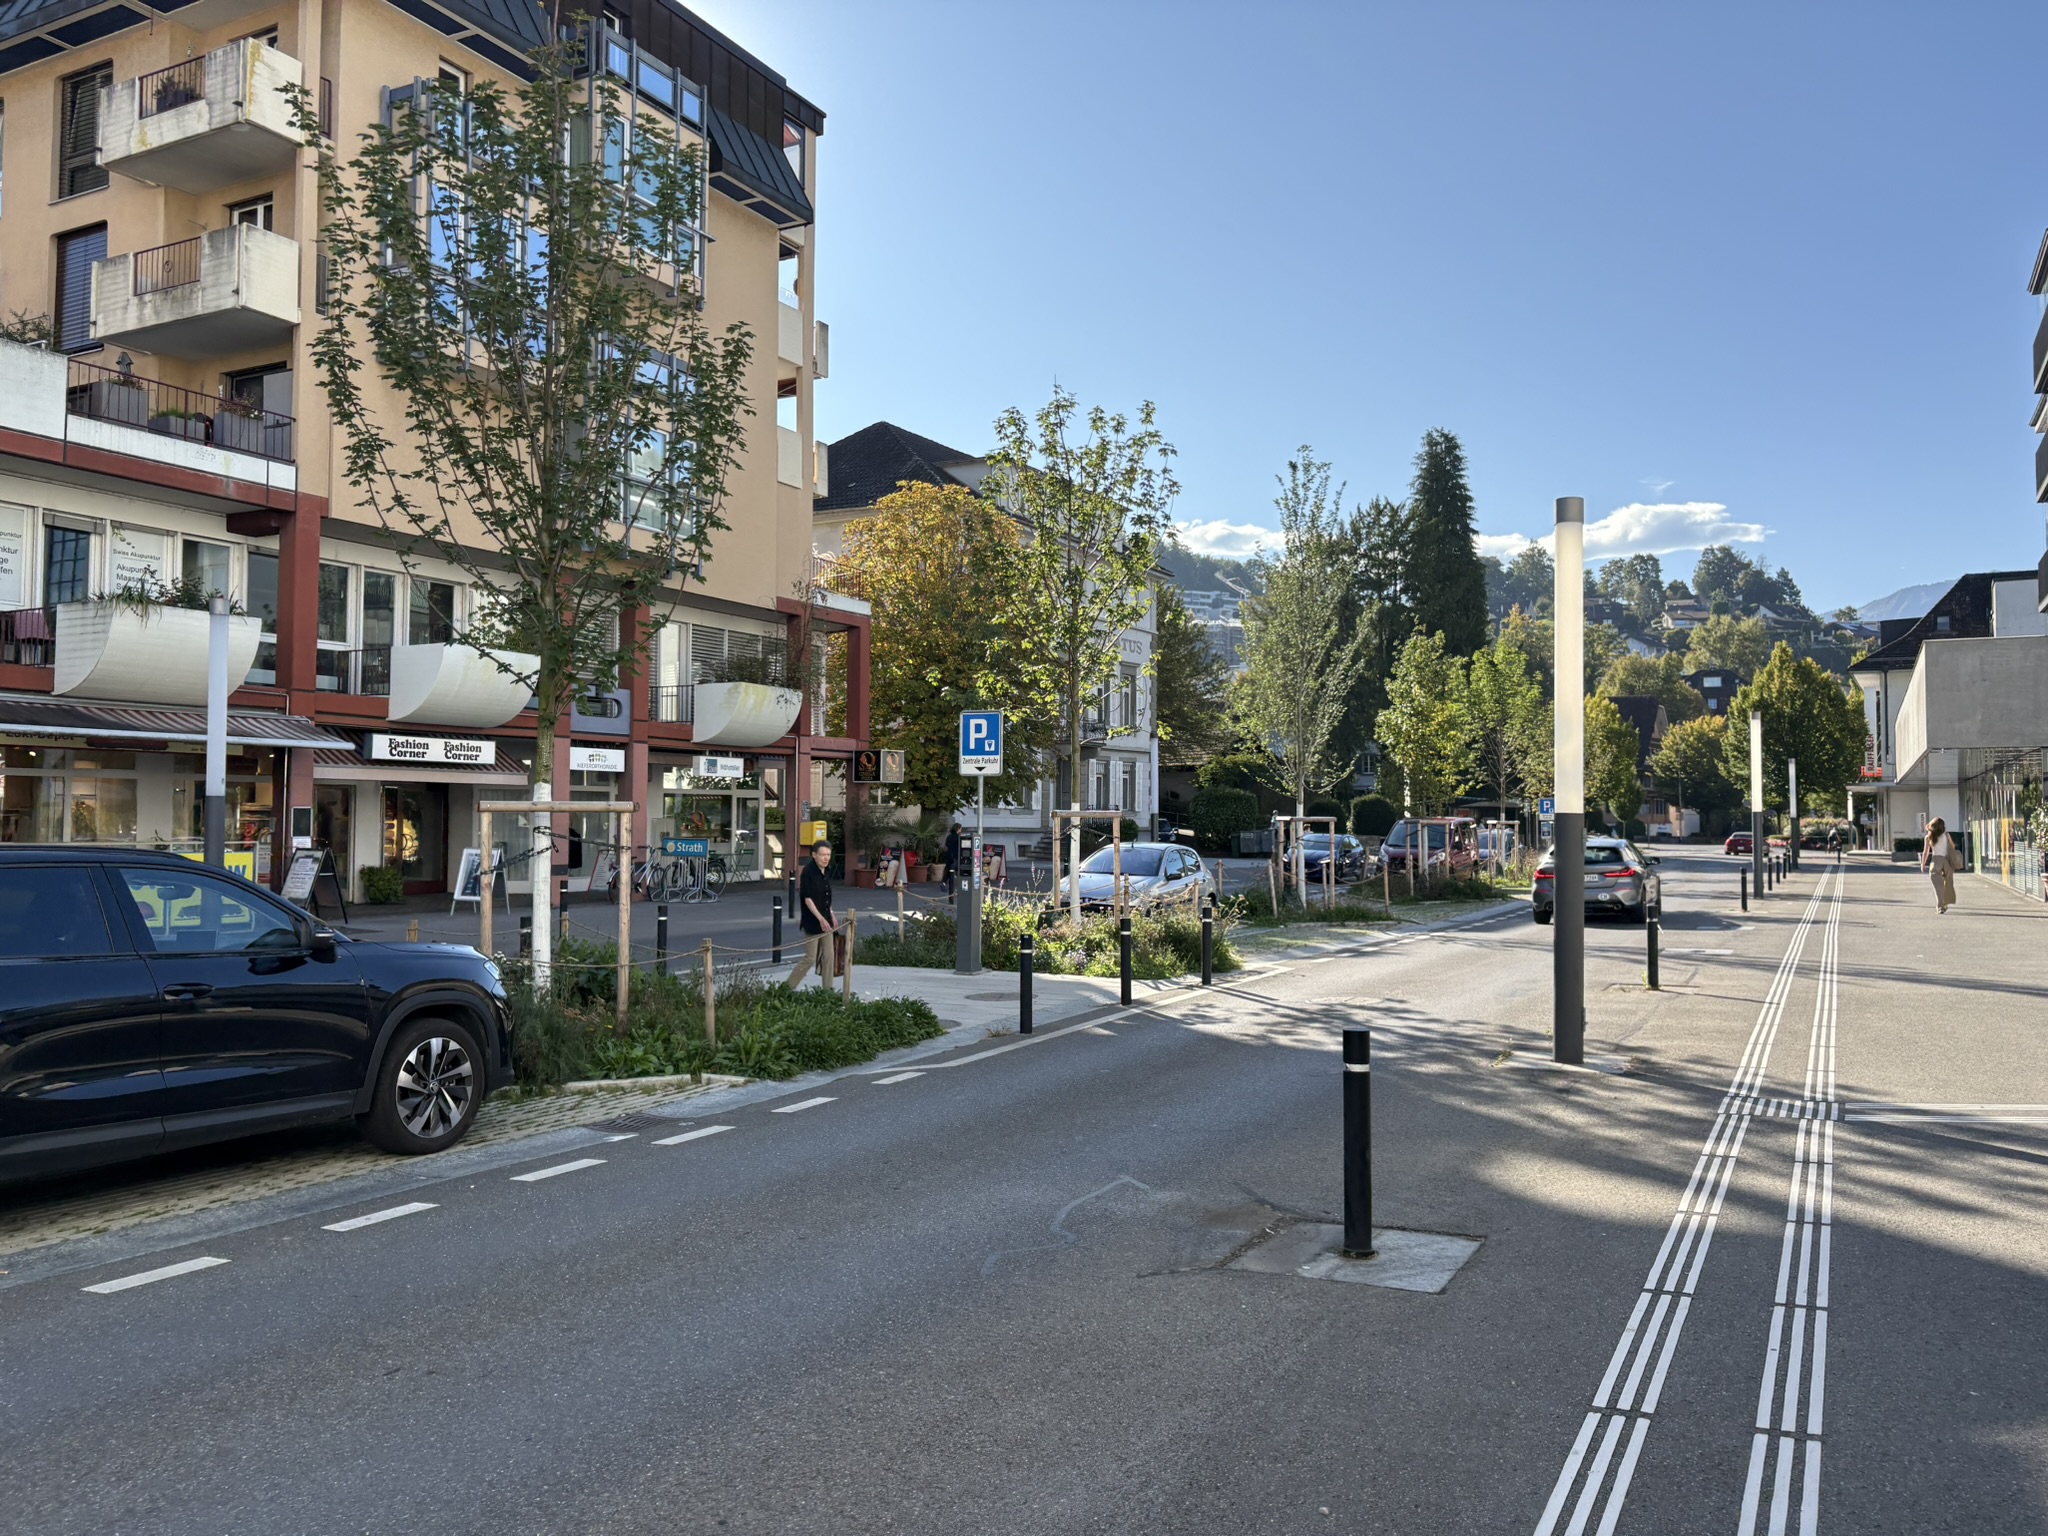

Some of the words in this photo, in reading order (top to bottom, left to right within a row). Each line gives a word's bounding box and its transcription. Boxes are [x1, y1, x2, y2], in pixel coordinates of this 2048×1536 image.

[112, 548, 129, 556] Swiss
[130, 551, 161, 560] Akupunktur
[969, 718, 988, 750] P
[388, 738, 429, 749] Fashion
[443, 741, 482, 753] Fashion
[389, 747, 427, 758] Corner
[444, 750, 480, 761] Corner
[962, 757, 981, 765] Zentrale
[981, 757, 999, 765] Parkuhr
[676, 842, 703, 853] Strath
